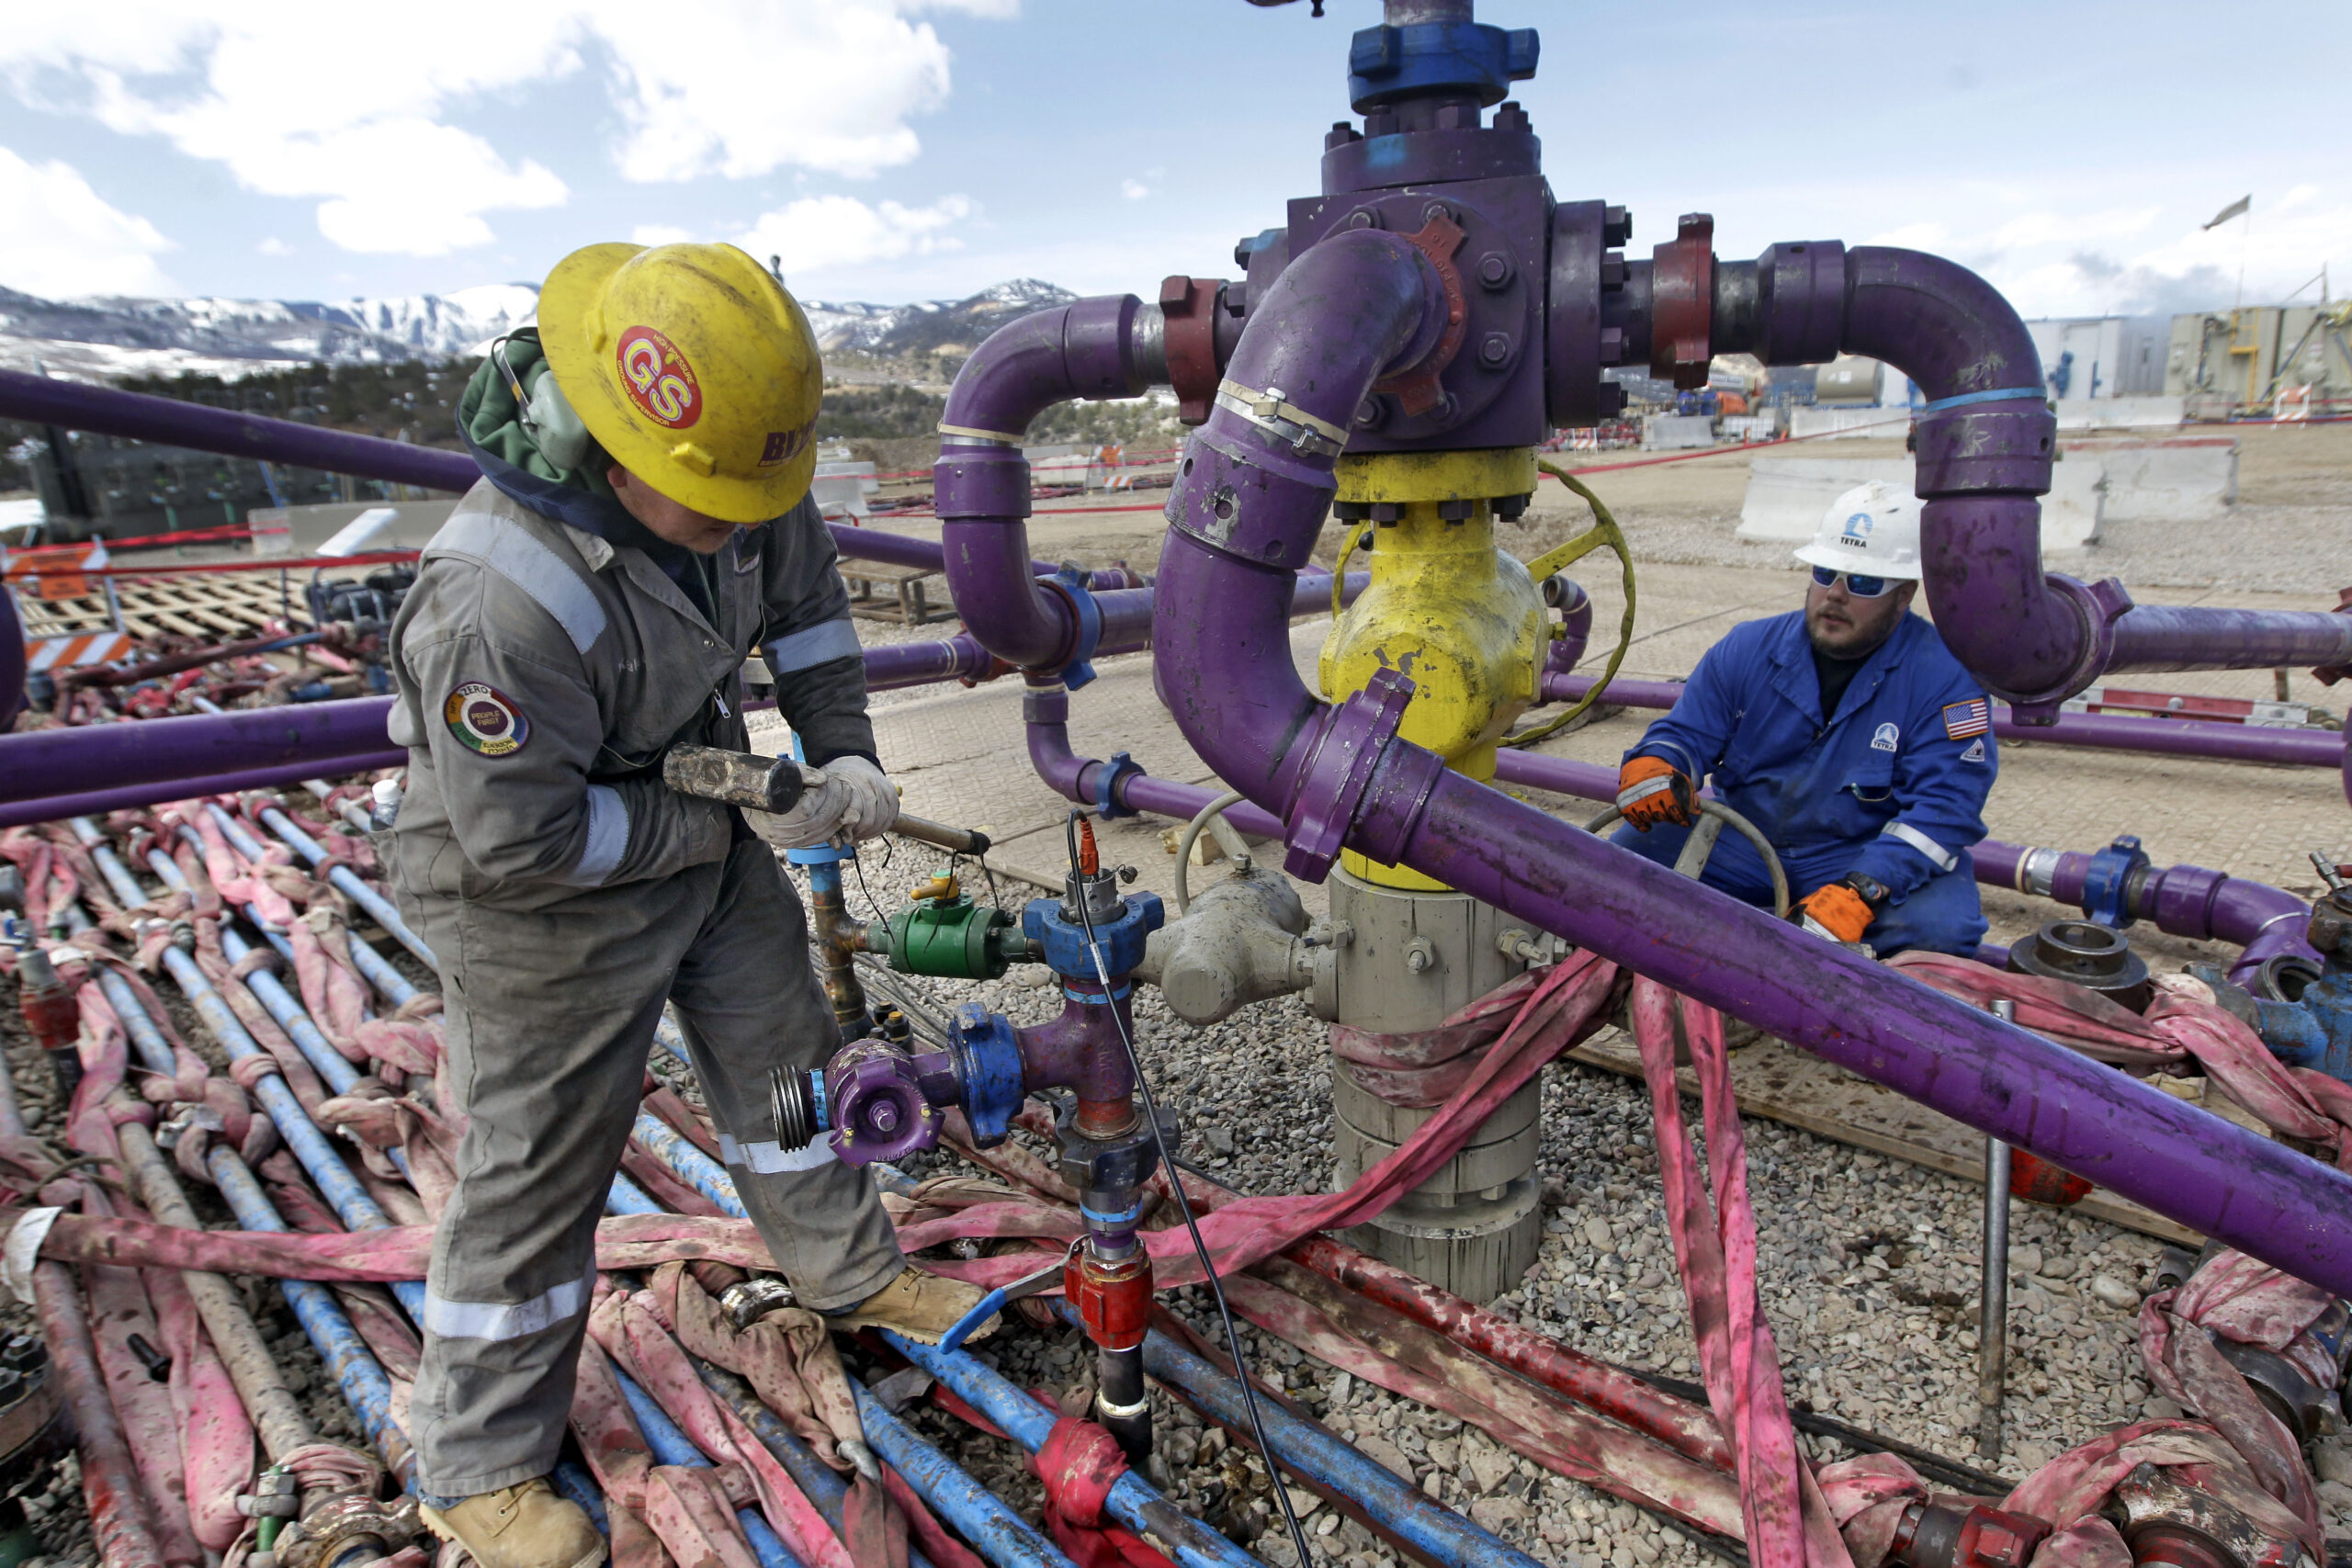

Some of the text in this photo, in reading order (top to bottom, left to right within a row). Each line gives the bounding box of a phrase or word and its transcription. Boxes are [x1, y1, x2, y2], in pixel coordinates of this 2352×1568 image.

[652, 333, 670, 351] HIGH
[623, 338, 693, 421] GS
[617, 359, 670, 426] GROUND SUPERVISOR
[1840, 536, 1867, 548] TETRA
[460, 685, 489, 696] ZERO
[471, 711, 500, 720] PEOPLE
[1873, 741, 1894, 750] TETRA
